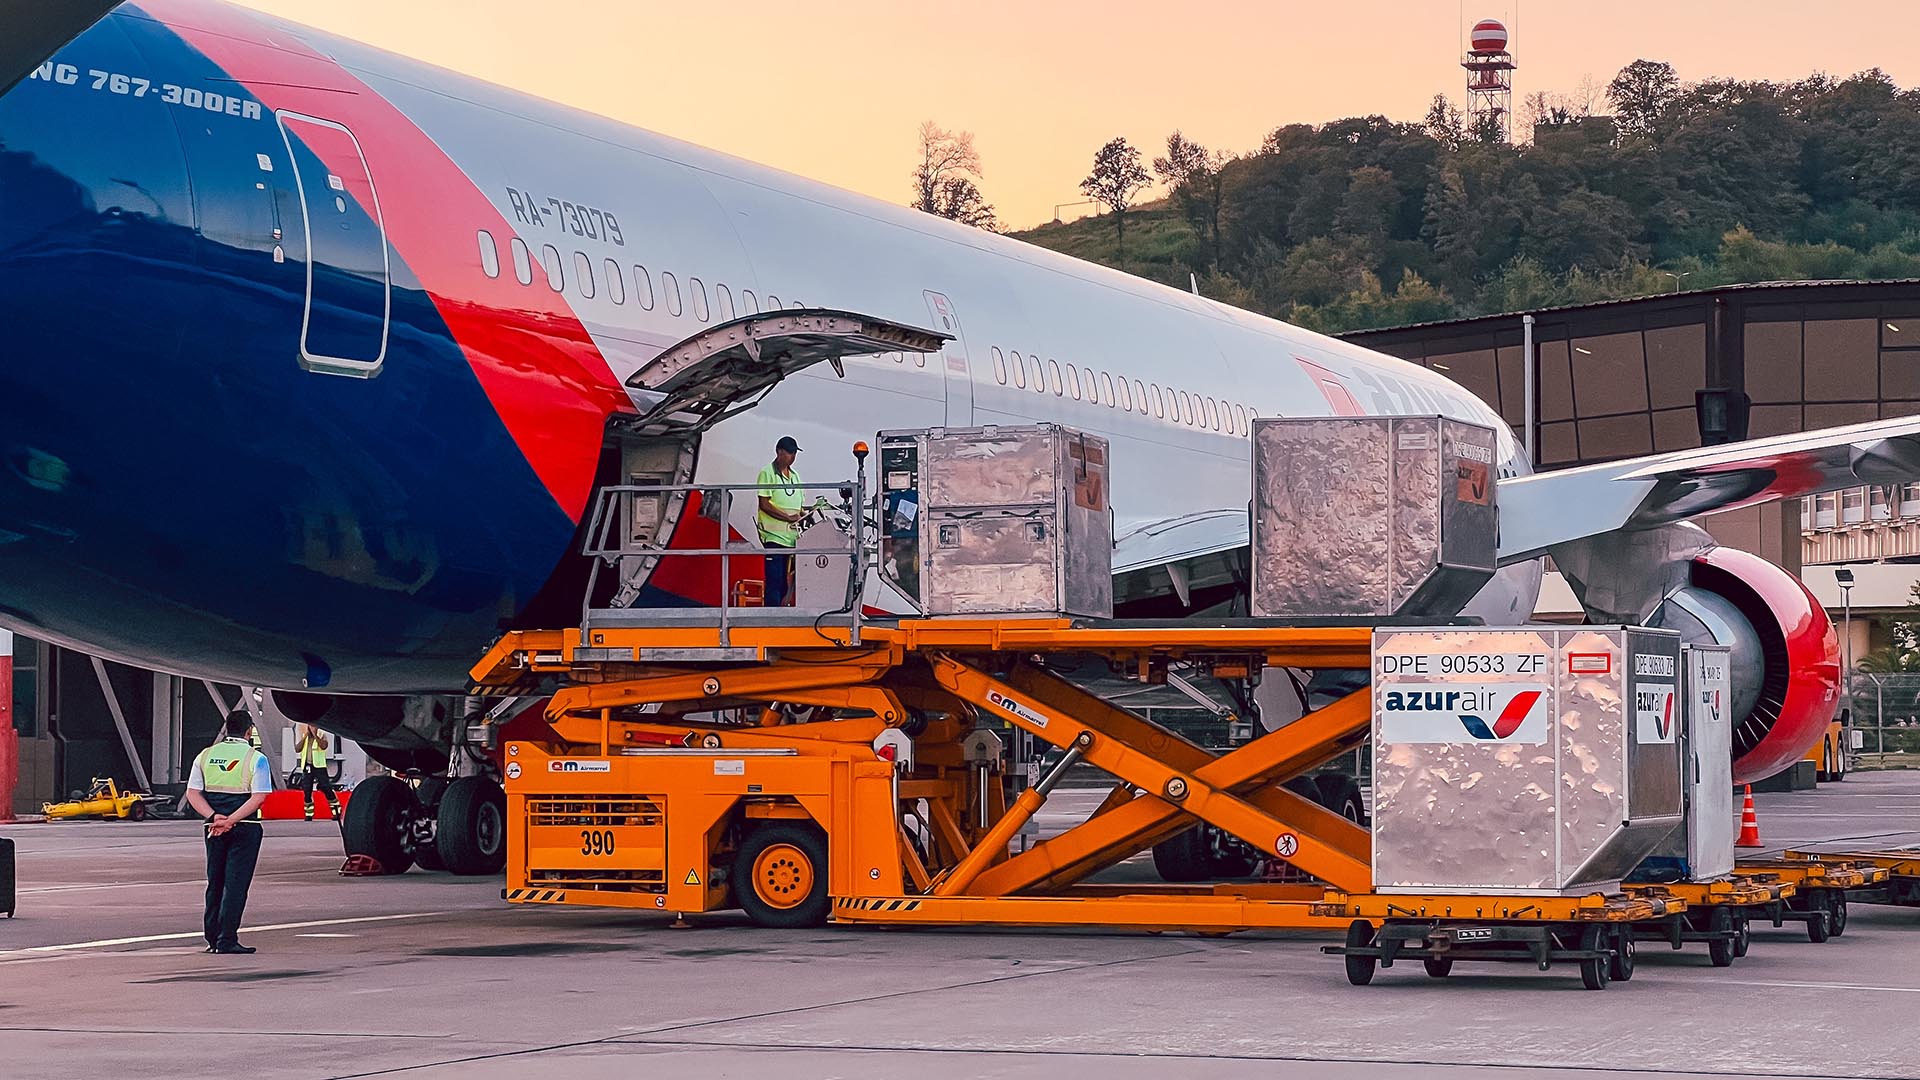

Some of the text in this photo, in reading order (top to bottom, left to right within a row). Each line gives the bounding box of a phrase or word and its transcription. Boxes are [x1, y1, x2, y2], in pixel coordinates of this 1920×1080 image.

[88, 69, 262, 120] 767-300ER
[505, 186, 625, 246] RA-73079
[1383, 655, 1545, 673] DPE 90533 ZF
[581, 830, 615, 856] 390
